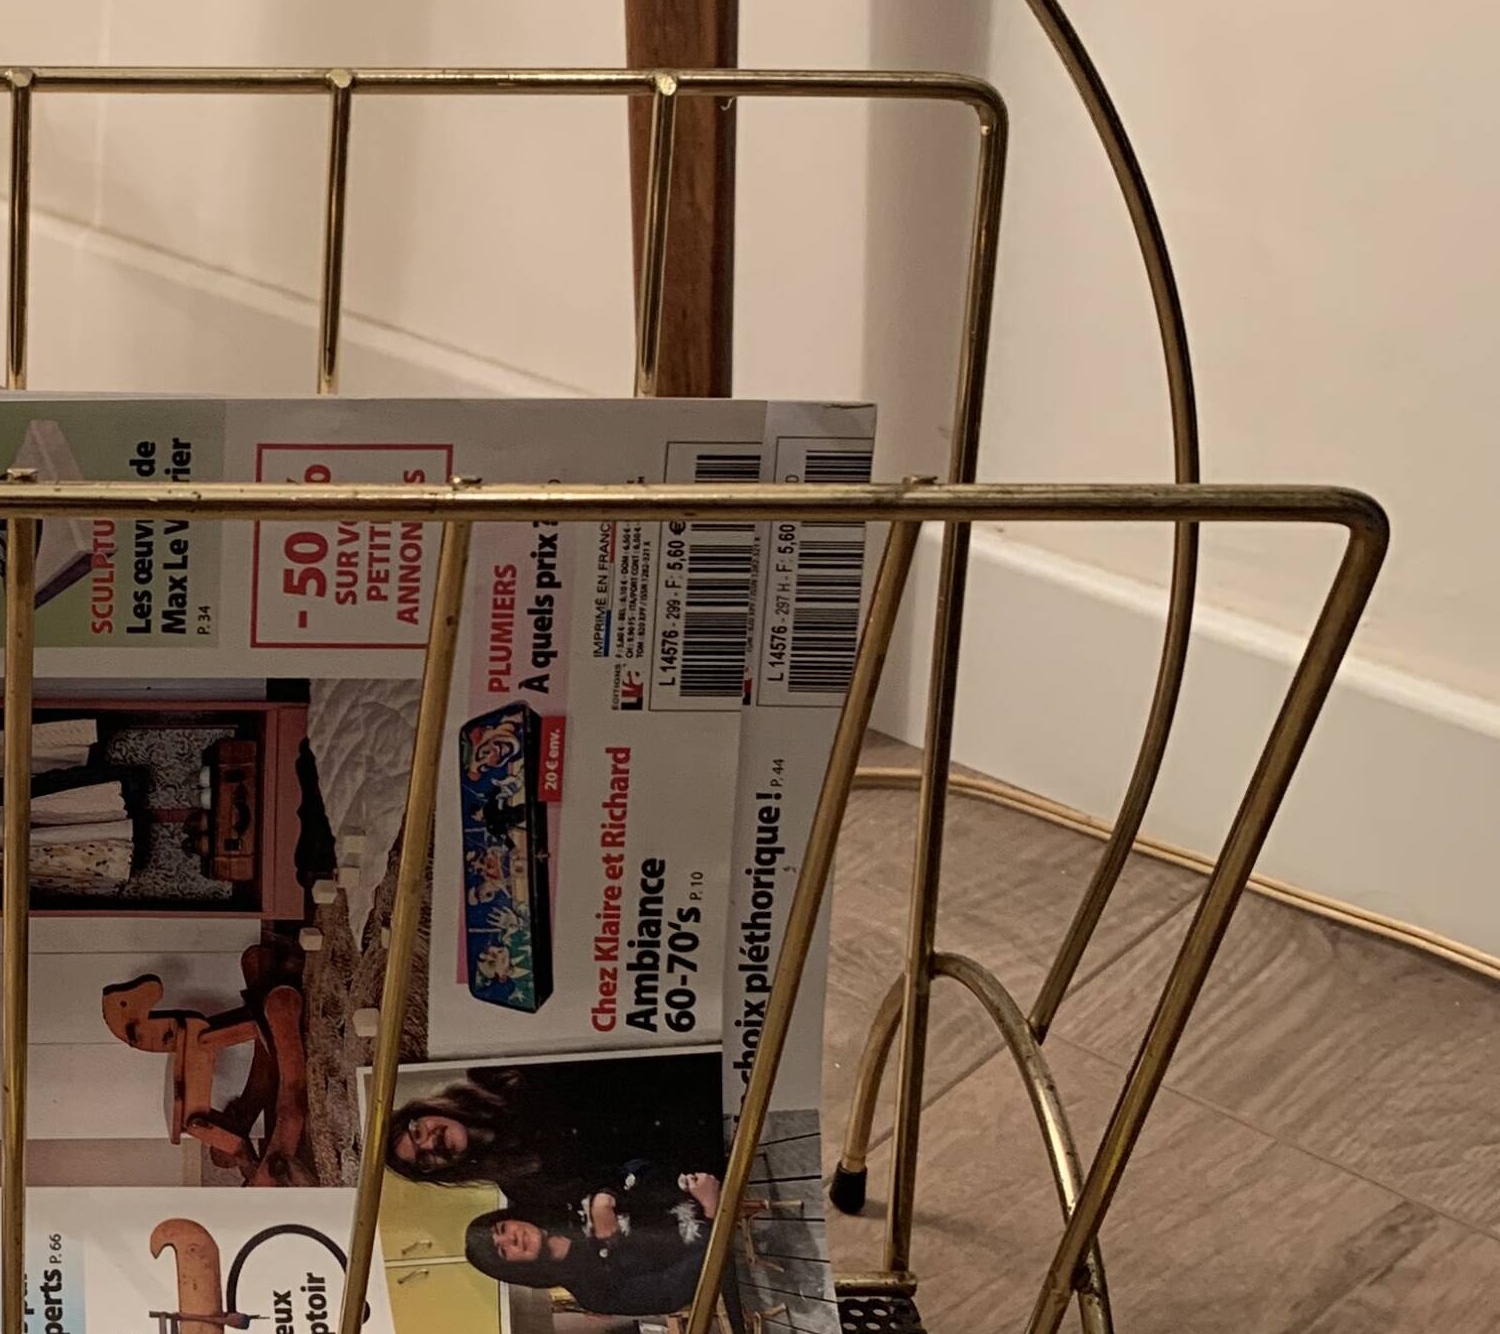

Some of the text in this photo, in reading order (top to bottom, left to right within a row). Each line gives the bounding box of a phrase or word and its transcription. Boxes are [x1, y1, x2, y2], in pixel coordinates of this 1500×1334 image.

[129, 441, 155, 477] de
[161, 438, 191, 635] Max Le Vrier
[397, 469, 425, 625] ANNONS
[667, 540, 686, 570] 5,60
[778, 524, 796, 554] 5,60
[91, 520, 114, 635] SCULPTU
[283, 532, 328, 598] 50
[335, 551, 359, 605] SUR
[530, 533, 561, 588] prix
[593, 522, 611, 658] IMPRIMÉ EN FRANC
[665, 599, 681, 619] 299
[774, 596, 790, 615] 297
[126, 590, 152, 634] Les
[198, 606, 211, 622] 34
[487, 564, 517, 693] PLUMIERS
[527, 595, 559, 668] quels
[661, 630, 679, 672] 14576
[770, 626, 788, 668] 14576
[519, 674, 550, 693] À
[659, 677, 675, 686] L
[768, 673, 784, 681] L
[548, 729, 561, 757] env.
[544, 771, 557, 791] 20
[591, 747, 631, 1032] Chez Klaire et Richard
[690, 871, 703, 887] 10
[737, 806, 786, 993] pléthorique
[772, 759, 785, 775] 44
[626, 858, 666, 1033] Ambiance
[49, 1234, 62, 1251] 66
